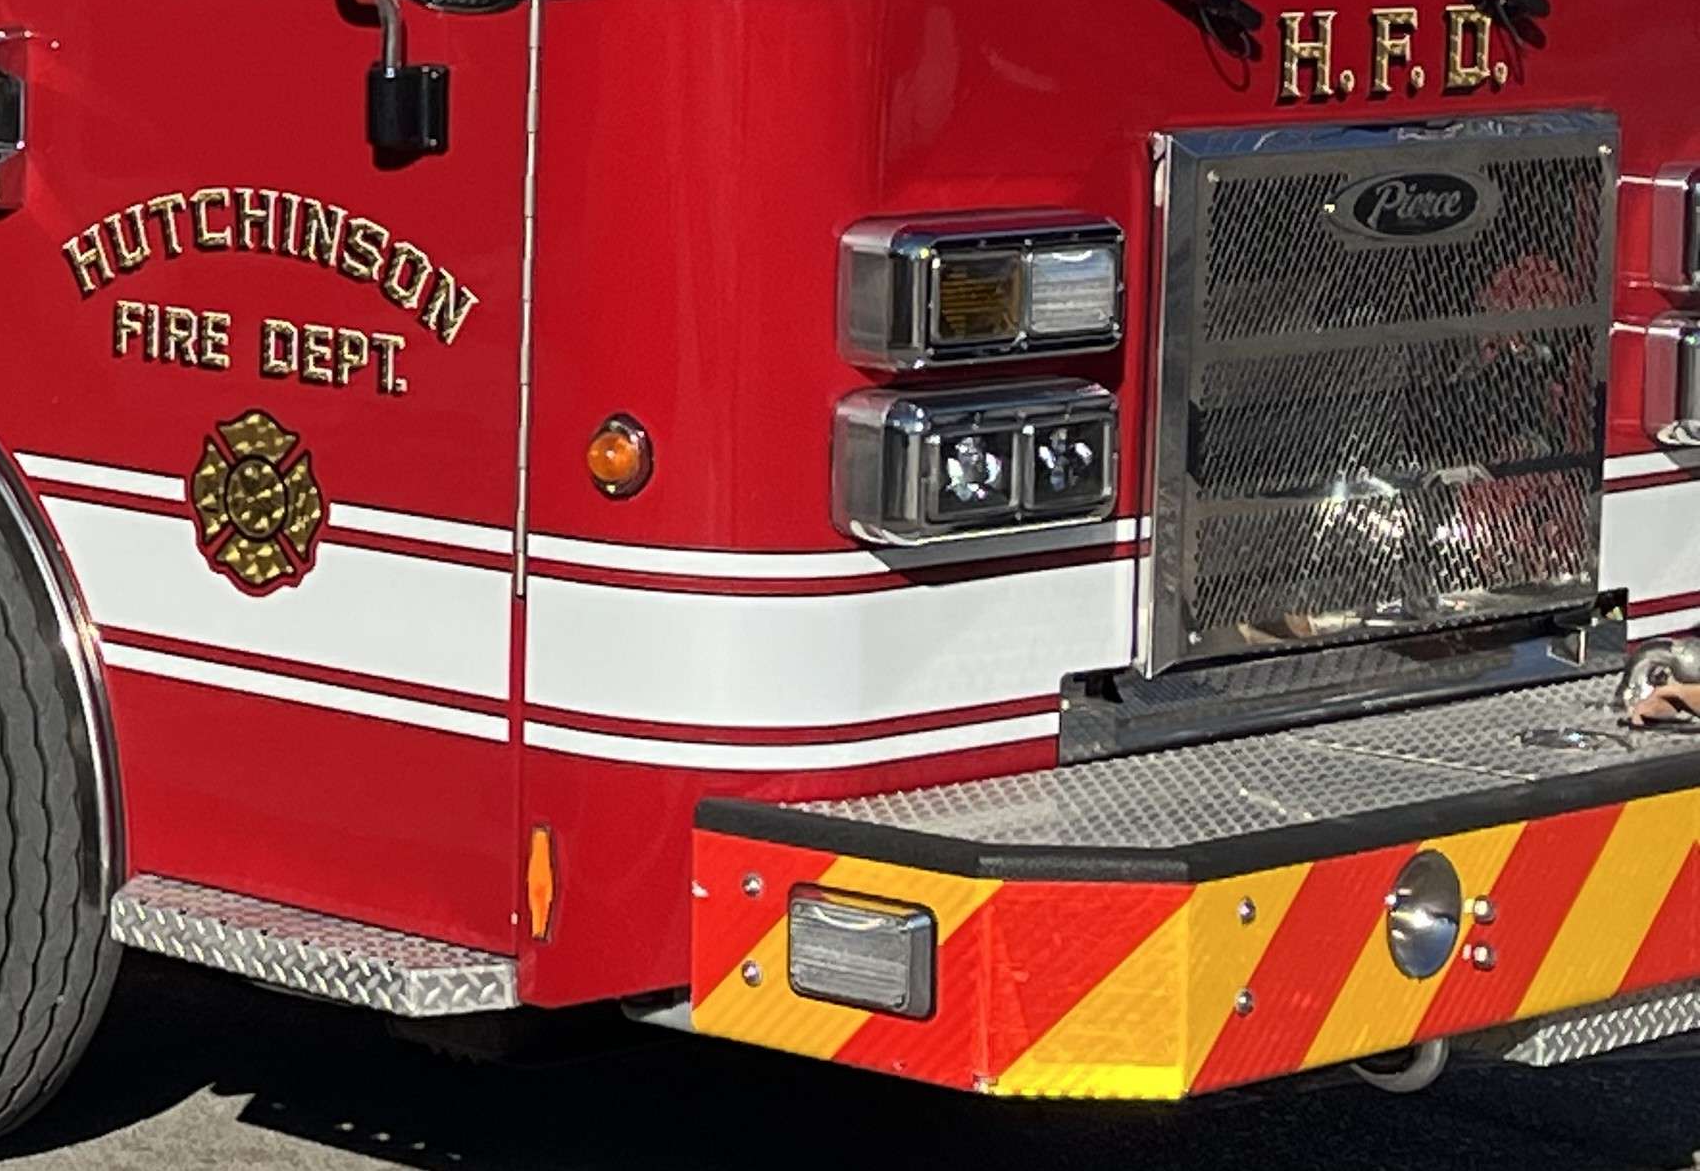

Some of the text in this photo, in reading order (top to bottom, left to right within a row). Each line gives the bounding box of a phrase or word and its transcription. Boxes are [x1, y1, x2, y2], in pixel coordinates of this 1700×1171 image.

[1366, 180, 1463, 228] Pierce
[62, 186, 480, 346] HUTCHINSON
[114, 299, 408, 394] FIRE DEPT.
